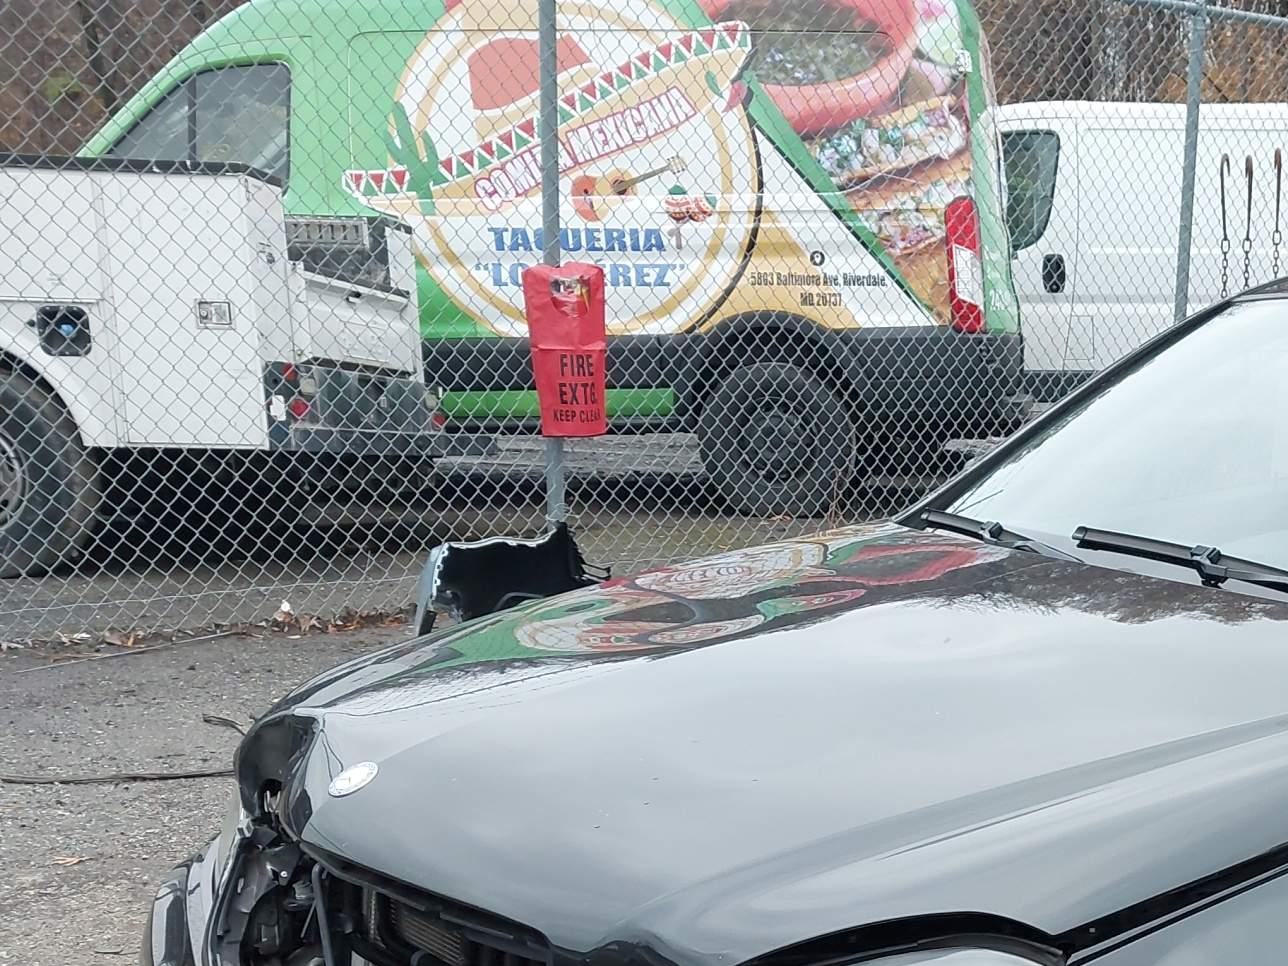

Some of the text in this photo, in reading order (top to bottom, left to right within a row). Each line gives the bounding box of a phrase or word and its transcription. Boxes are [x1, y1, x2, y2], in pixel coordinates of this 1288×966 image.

[565, 85, 697, 164] MEXICANA
[776, 272, 821, 286] Baltimore
[816, 292, 842, 307] 20737
[560, 354, 595, 377] FIRE
[553, 409, 576, 423] KEEP
